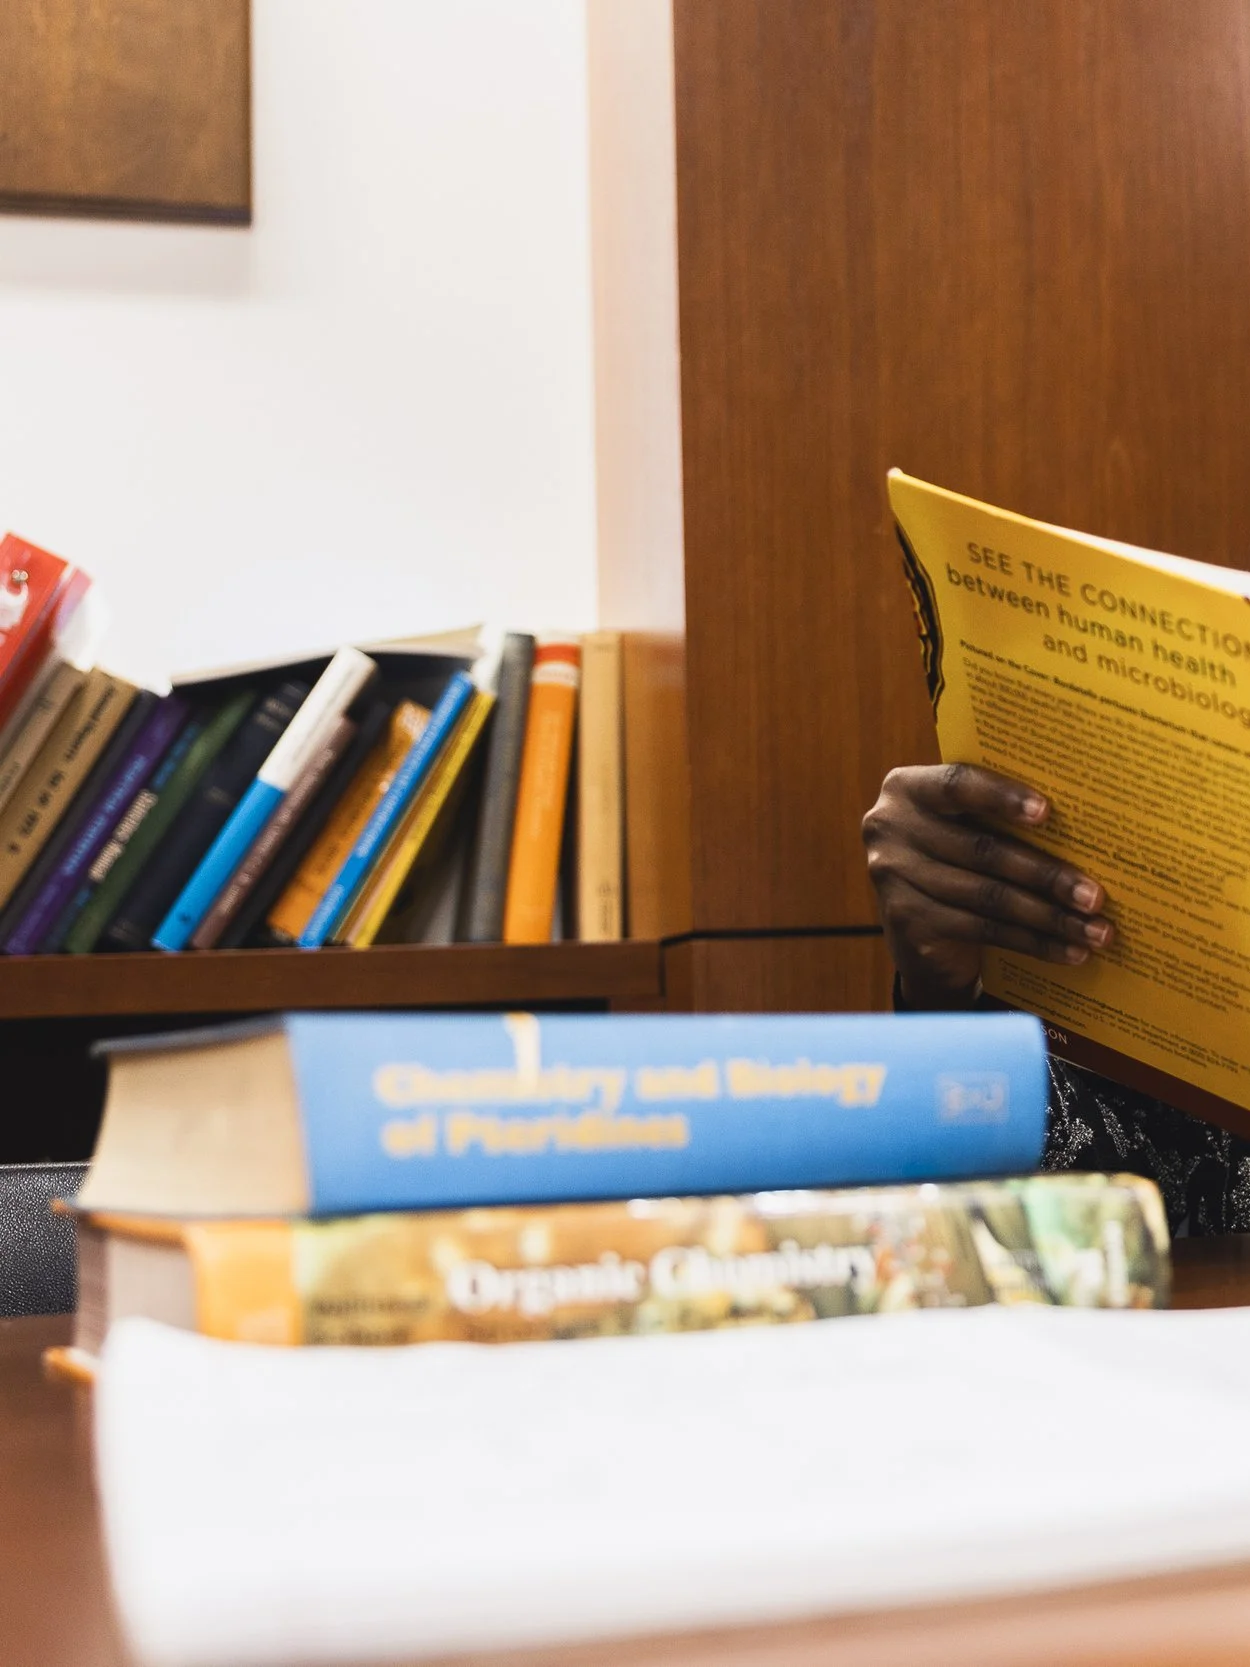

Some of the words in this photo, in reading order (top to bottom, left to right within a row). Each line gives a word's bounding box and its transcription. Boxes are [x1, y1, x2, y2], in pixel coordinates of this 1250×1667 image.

[966, 541, 1012, 579] SEE
[1022, 561, 1072, 597] THE
[945, 562, 1050, 620] between
[1057, 602, 1145, 654] human
[1152, 637, 1237, 688] health
[1042, 631, 1088, 665] and
